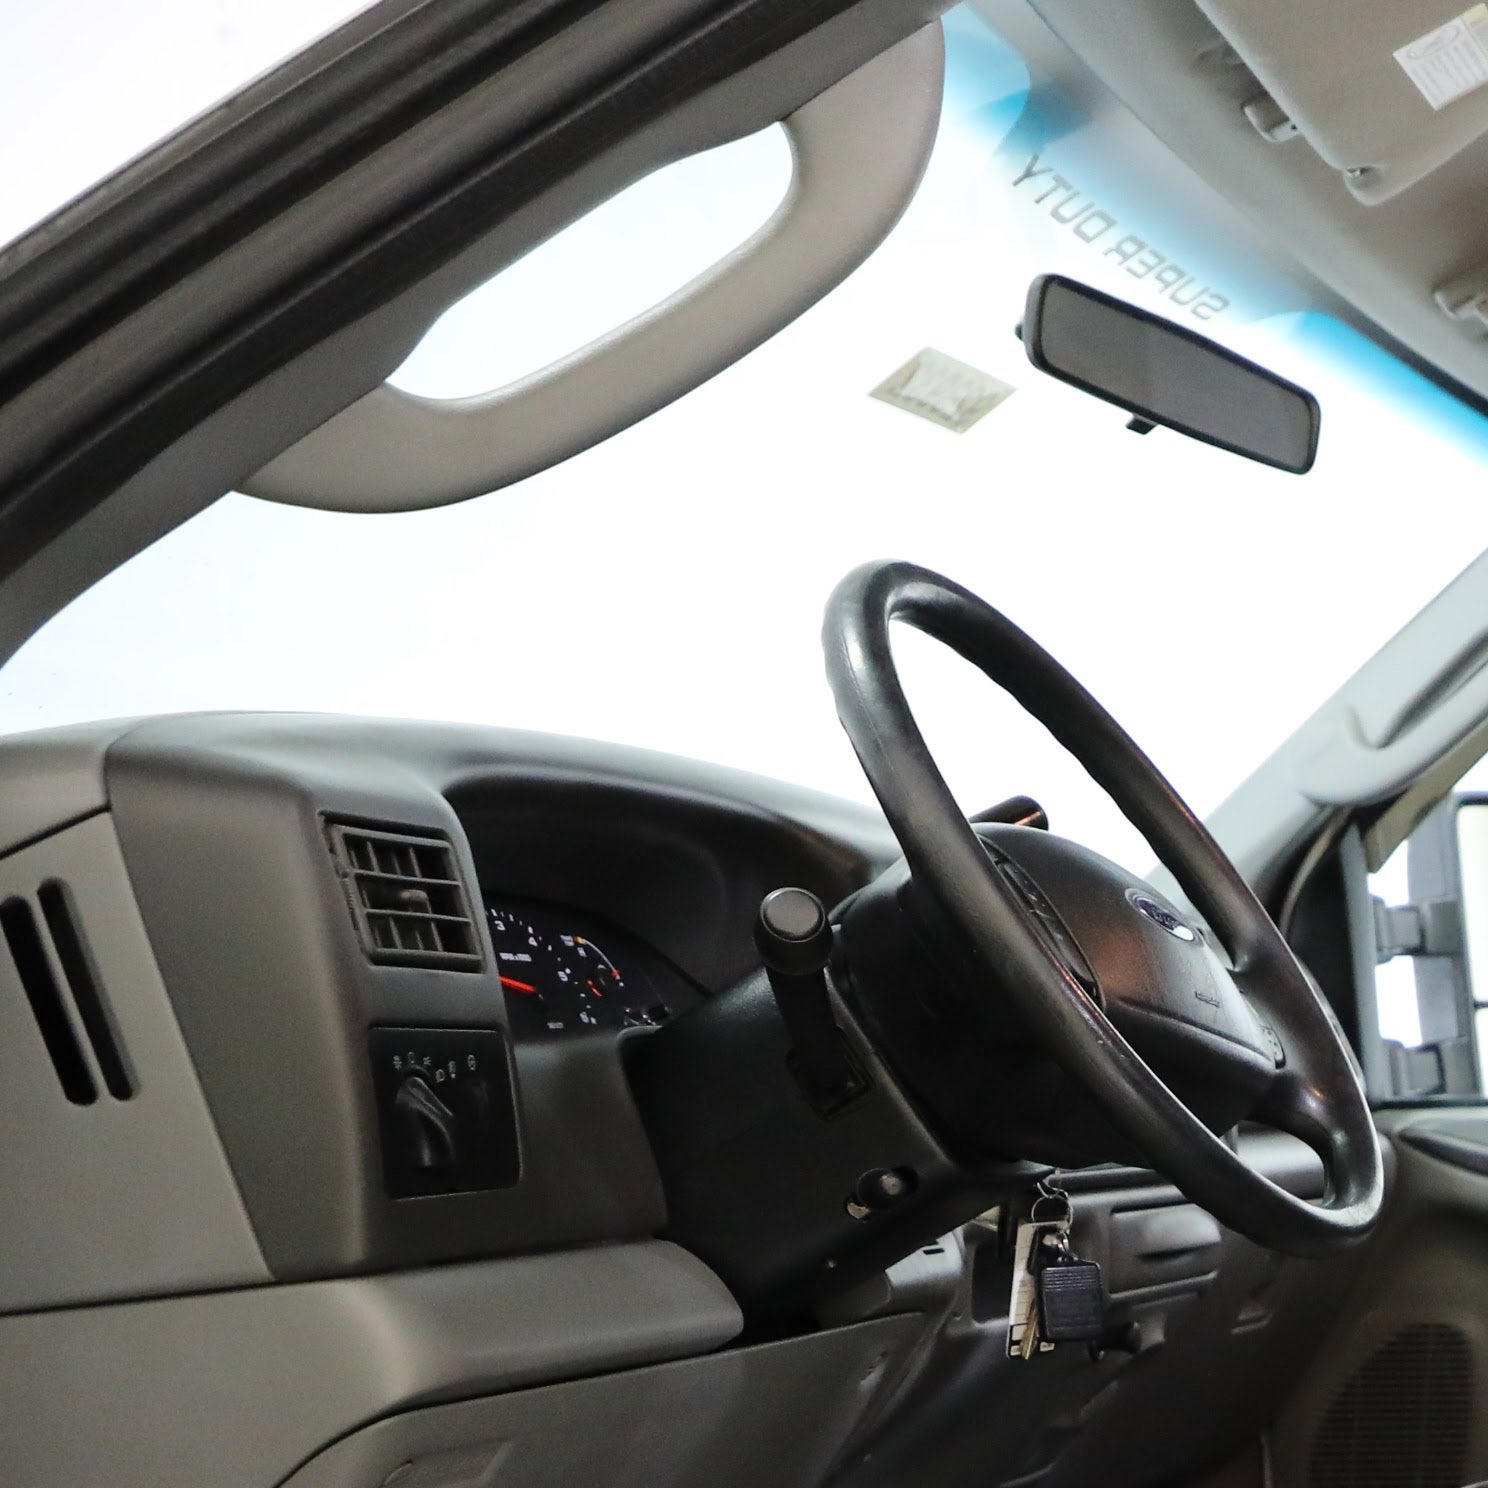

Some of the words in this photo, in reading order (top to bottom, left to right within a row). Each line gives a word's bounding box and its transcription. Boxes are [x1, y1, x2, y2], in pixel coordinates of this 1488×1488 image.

[494, 920, 506, 931] 3
[528, 936, 538, 947] 4
[557, 970, 568, 982] 5
